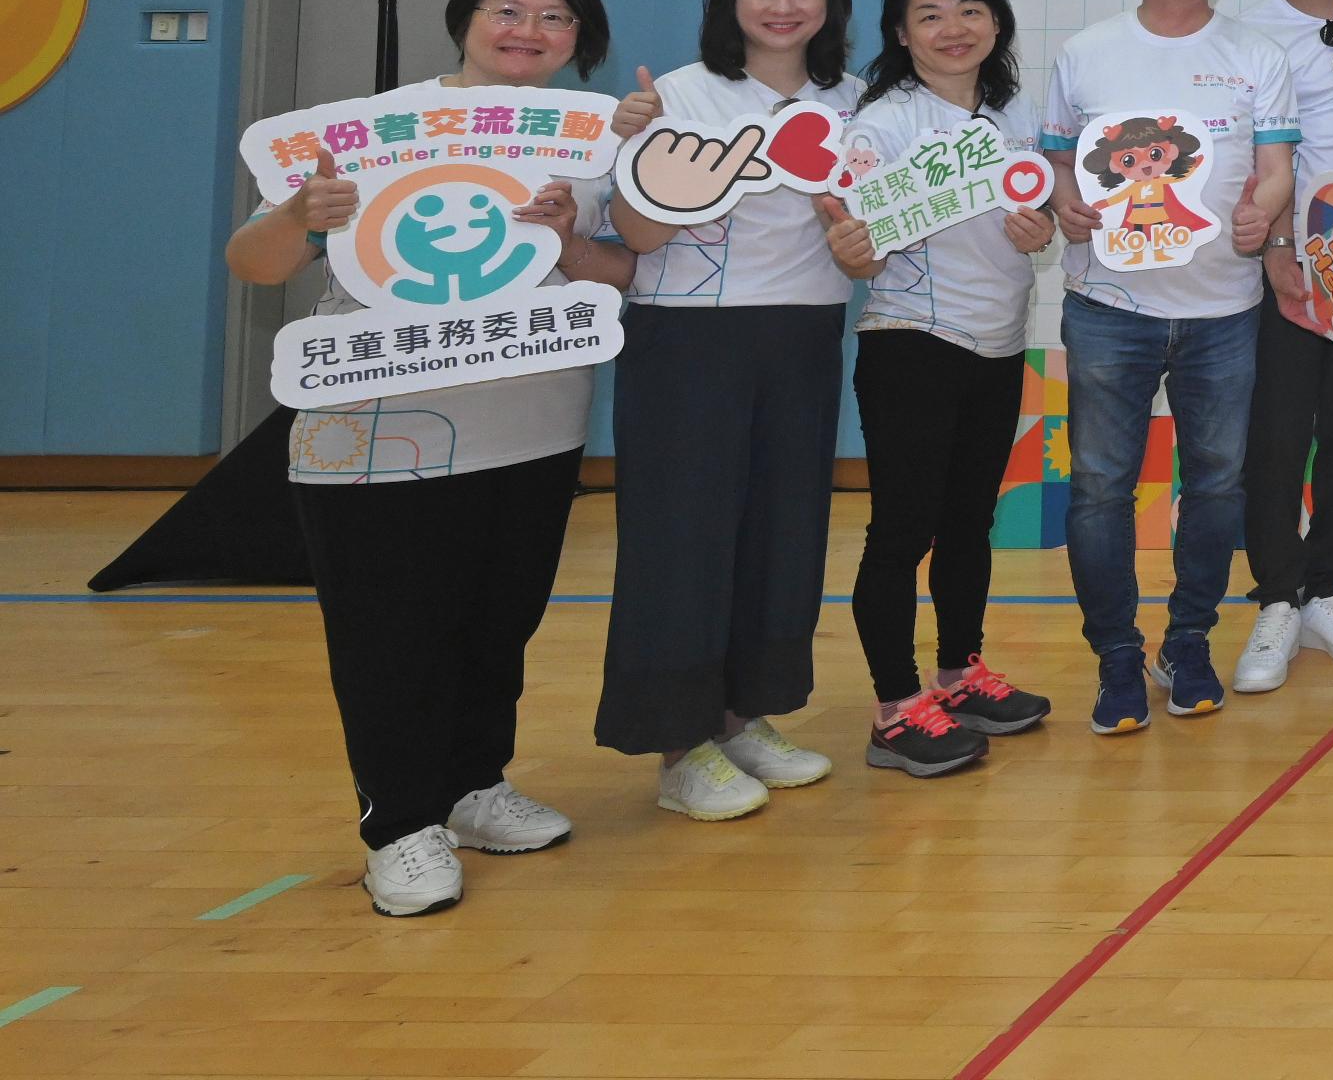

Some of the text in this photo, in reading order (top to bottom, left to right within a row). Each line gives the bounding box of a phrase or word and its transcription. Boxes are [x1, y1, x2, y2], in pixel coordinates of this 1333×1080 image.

[269, 106, 606, 169] 持份者交流活動
[448, 142, 593, 162] Engagement
[852, 126, 1005, 216] 凝聚家庭
[868, 178, 996, 251] 齊抗暴力
[300, 333, 601, 390] Commission on Children
[301, 301, 598, 369] 兒童事務委員會
